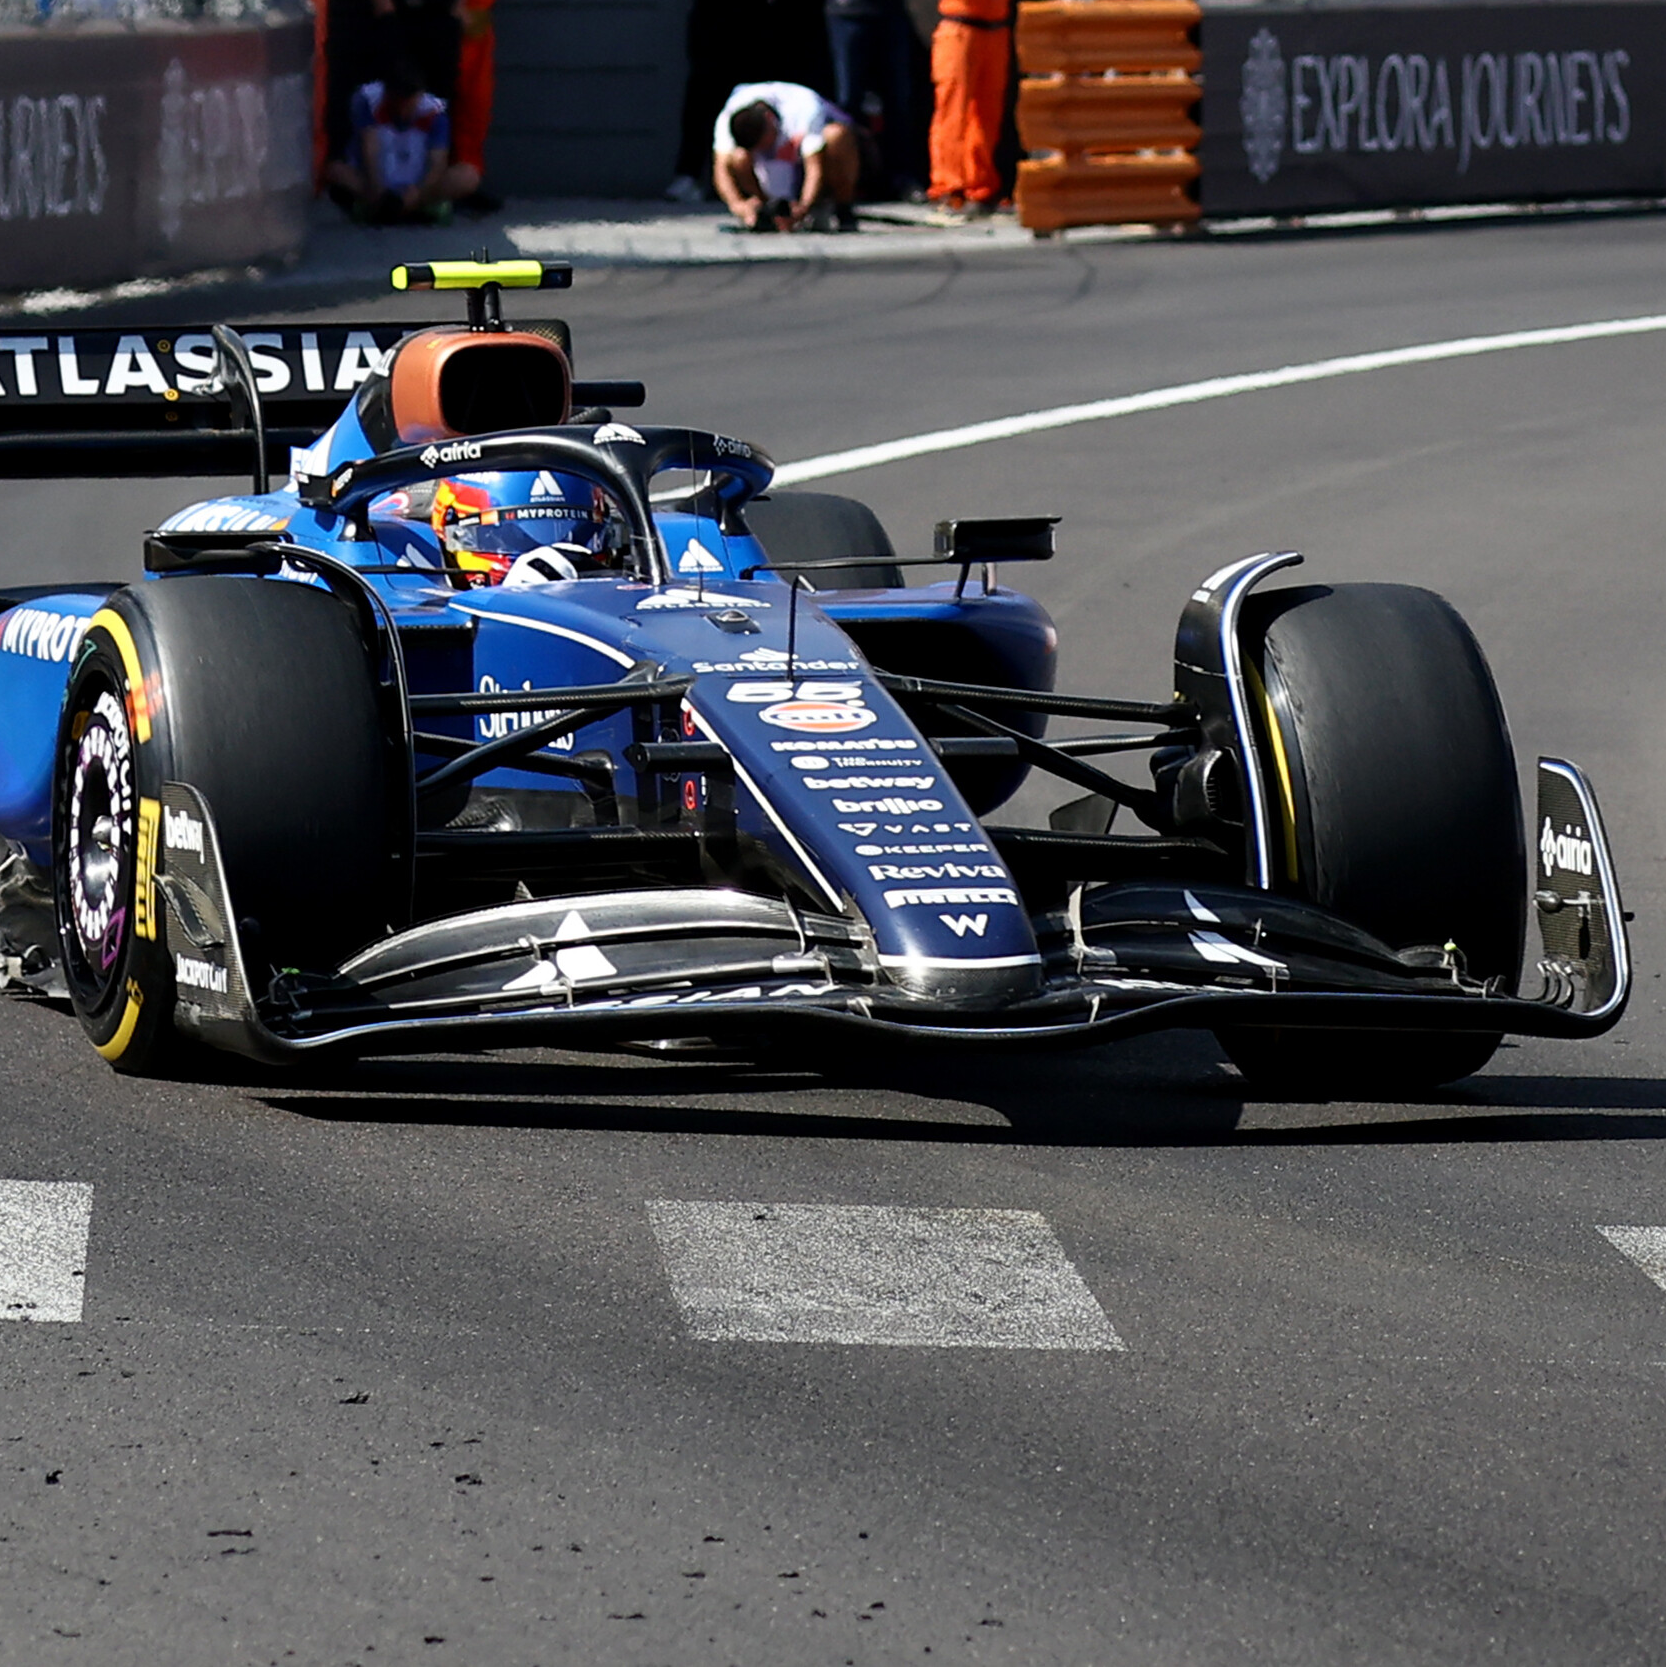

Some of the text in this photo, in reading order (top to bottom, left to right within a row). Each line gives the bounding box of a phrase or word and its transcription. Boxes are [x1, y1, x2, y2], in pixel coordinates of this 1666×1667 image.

[1290, 48, 1632, 175] EXPLORA JOURNEYS
[439, 441, 482, 463] airia
[516, 508, 589, 520] MYPROTEIN
[692, 660, 860, 673] Santander
[726, 680, 863, 703] 55
[770, 738, 918, 752] KOMATSU
[803, 776, 935, 790] betway
[833, 797, 944, 815] brillio
[883, 822, 972, 834] VAST
[883, 843, 990, 854] KEEPER
[1555, 823, 1592, 876] airia
[867, 862, 1008, 881] Reviva
[883, 887, 1019, 909] PIRELLI
[938, 913, 989, 937] W
